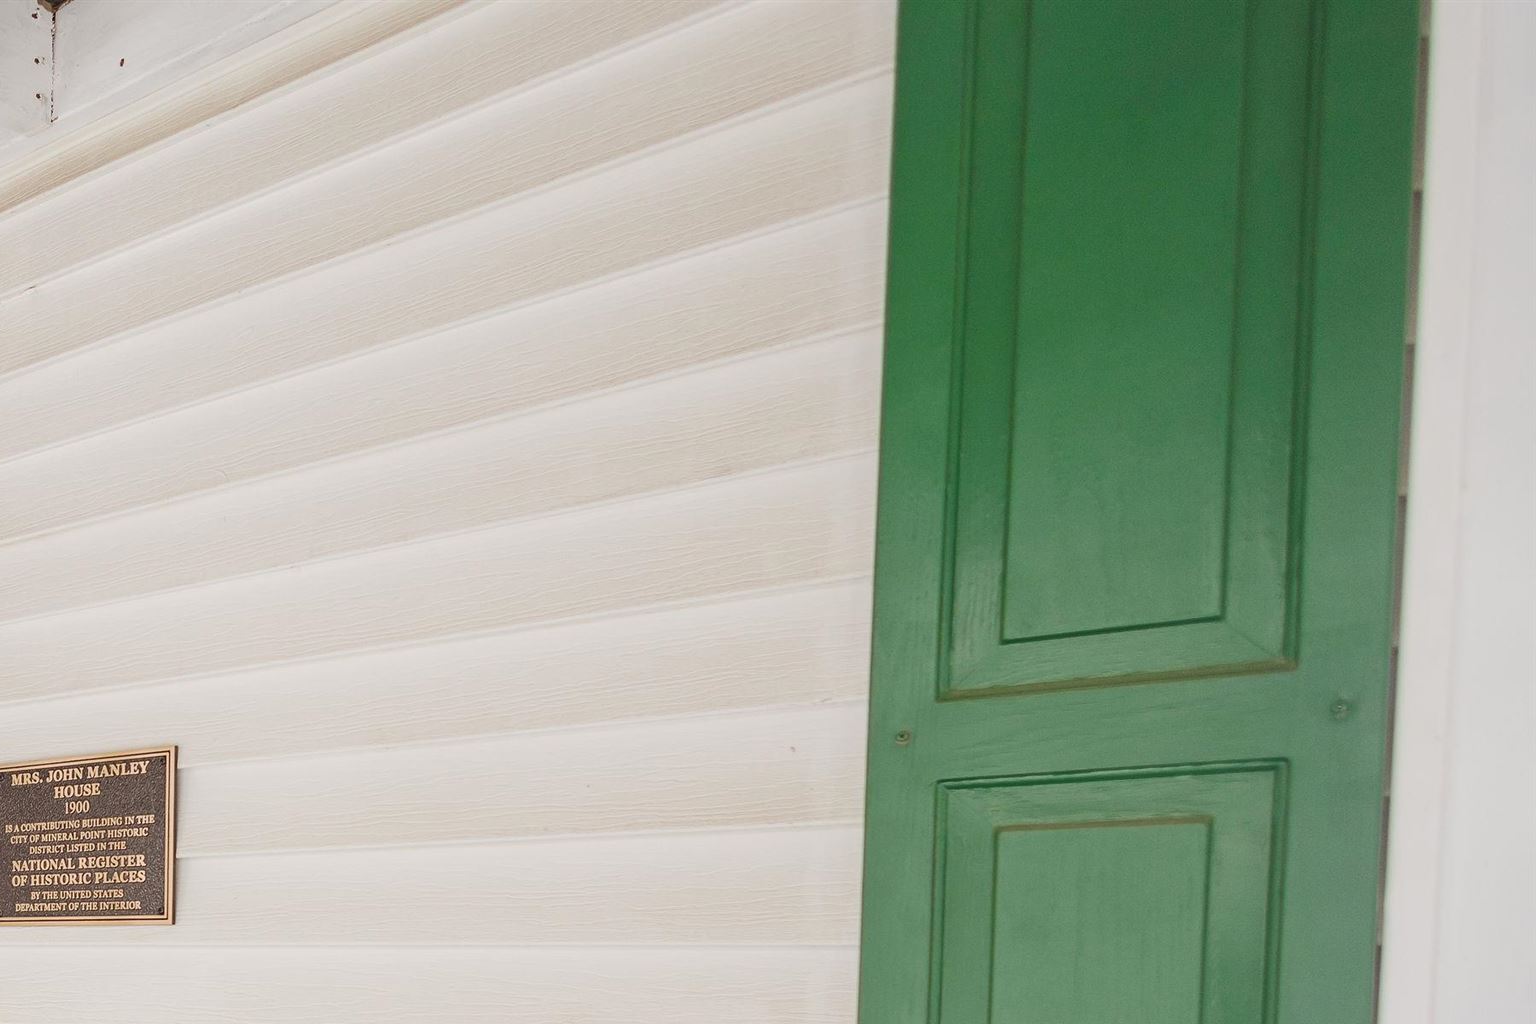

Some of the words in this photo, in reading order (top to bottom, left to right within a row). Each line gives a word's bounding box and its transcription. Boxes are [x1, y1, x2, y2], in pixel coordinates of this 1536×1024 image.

[11, 772, 43, 786] MRS.
[46, 767, 83, 783] JOHN
[87, 761, 150, 778] MANLEY
[54, 783, 101, 798] HOUSE
[65, 801, 90, 814] 1900
[5, 824, 13, 833] IS
[14, 824, 20, 832] A
[21, 819, 80, 832] CONTRIBUTING
[82, 817, 123, 827] BUILDING
[125, 816, 135, 824] IN
[136, 815, 155, 824] THE
[10, 835, 28, 844] CITY
[29, 834, 40, 842] OF
[42, 831, 78, 841] MINERAL
[80, 831, 105, 840] POINT
[107, 828, 148, 838] HISTORIC
[30, 844, 66, 854] DISTRICT
[67, 843, 95, 852] LISTED
[97, 842, 107, 851] IN
[108, 841, 126, 850] THE
[12, 858, 75, 872] NATIONAL
[78, 855, 146, 868] REGISTER
[12, 875, 28, 886] OF
[30, 872, 92, 886] HISTORIC
[95, 870, 146, 883] PLACES
[31, 892, 41, 900] BY
[60, 890, 91, 899] UNITED
[93, 889, 124, 898] STATES
[15, 902, 67, 912] DEPARTMENT
[68, 902, 79, 910] OF
[81, 901, 98, 910] THE
[99, 901, 141, 909] INTERIOR
